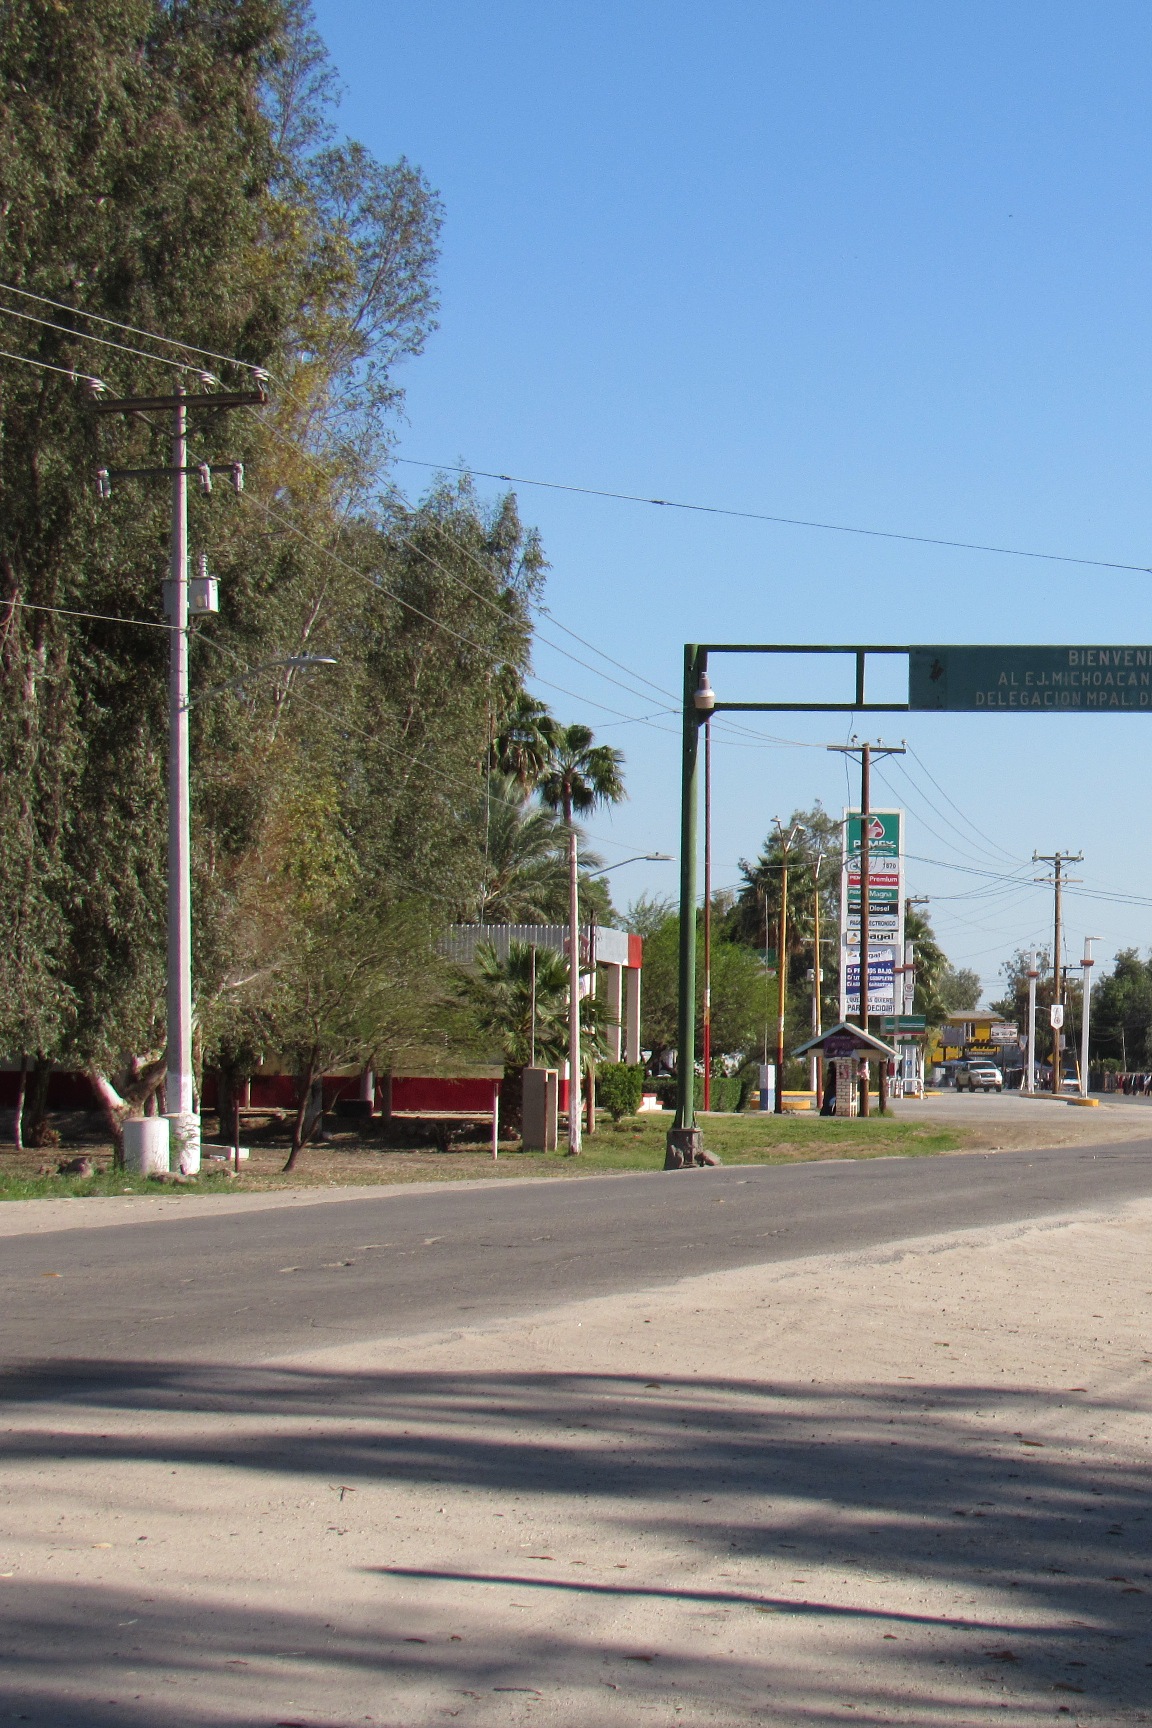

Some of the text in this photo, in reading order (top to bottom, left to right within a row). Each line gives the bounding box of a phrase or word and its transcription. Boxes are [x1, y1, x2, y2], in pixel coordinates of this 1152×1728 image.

[998, 671, 1019, 686] AL
[975, 691, 1081, 706] DELEGACION
[1086, 691, 1134, 706] MPAL.
[853, 839, 894, 849] PMEX
[869, 875, 898, 883] Premium
[869, 890, 892, 898] Magna
[869, 904, 890, 912] Diesel
[868, 932, 894, 941] agal
